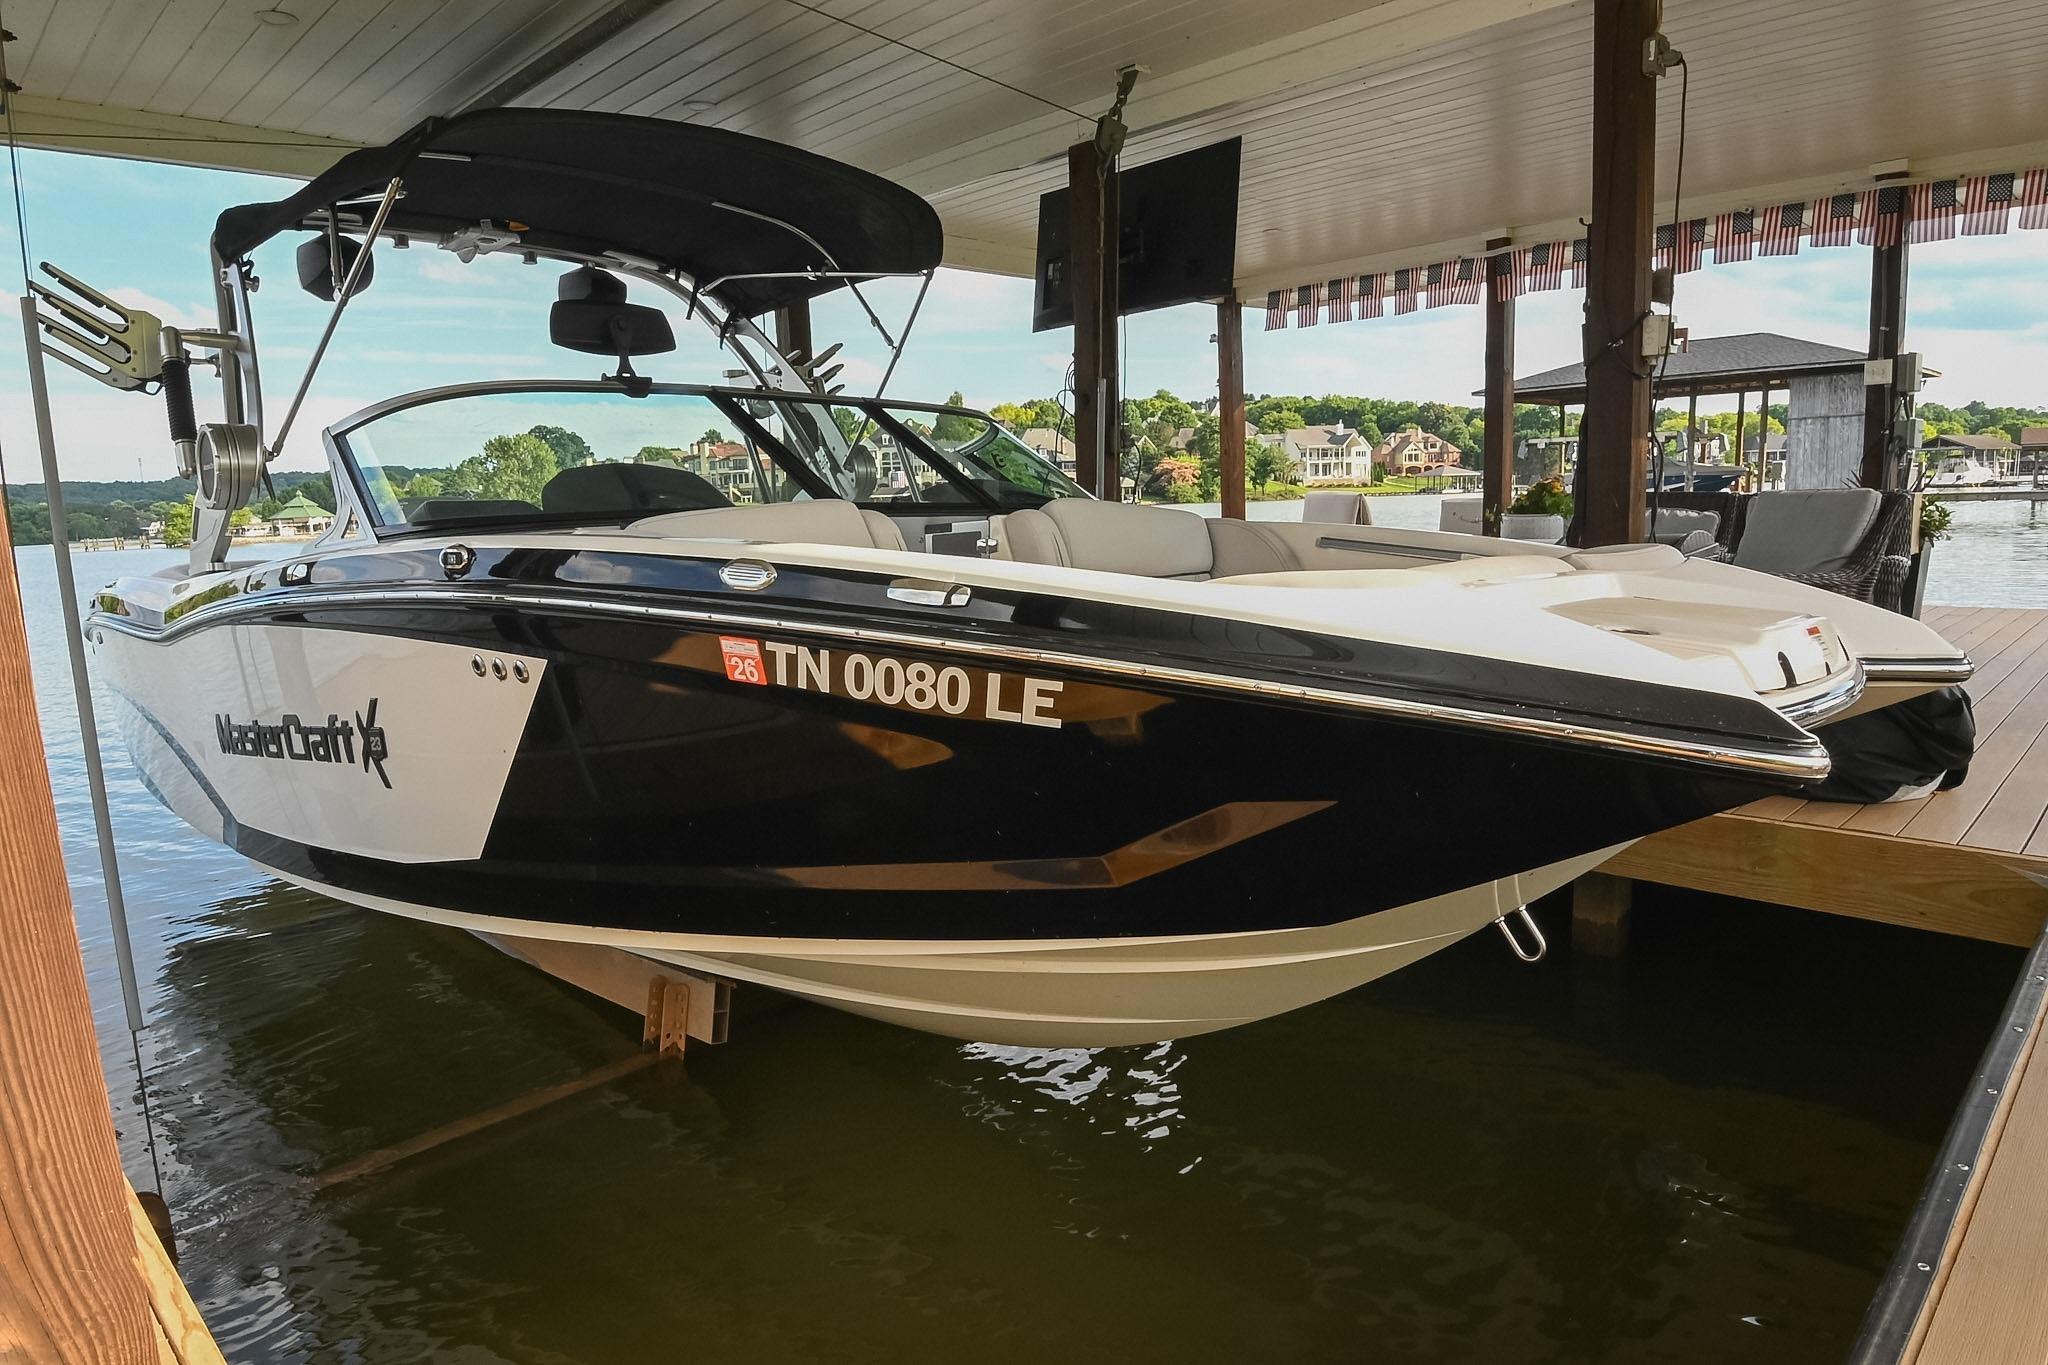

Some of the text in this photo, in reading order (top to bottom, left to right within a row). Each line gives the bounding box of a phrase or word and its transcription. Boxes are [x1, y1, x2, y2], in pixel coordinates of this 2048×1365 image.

[731, 656, 759, 682] 26
[765, 641, 1064, 729] TN 0080 LE
[215, 713, 356, 764] MasterCraft
